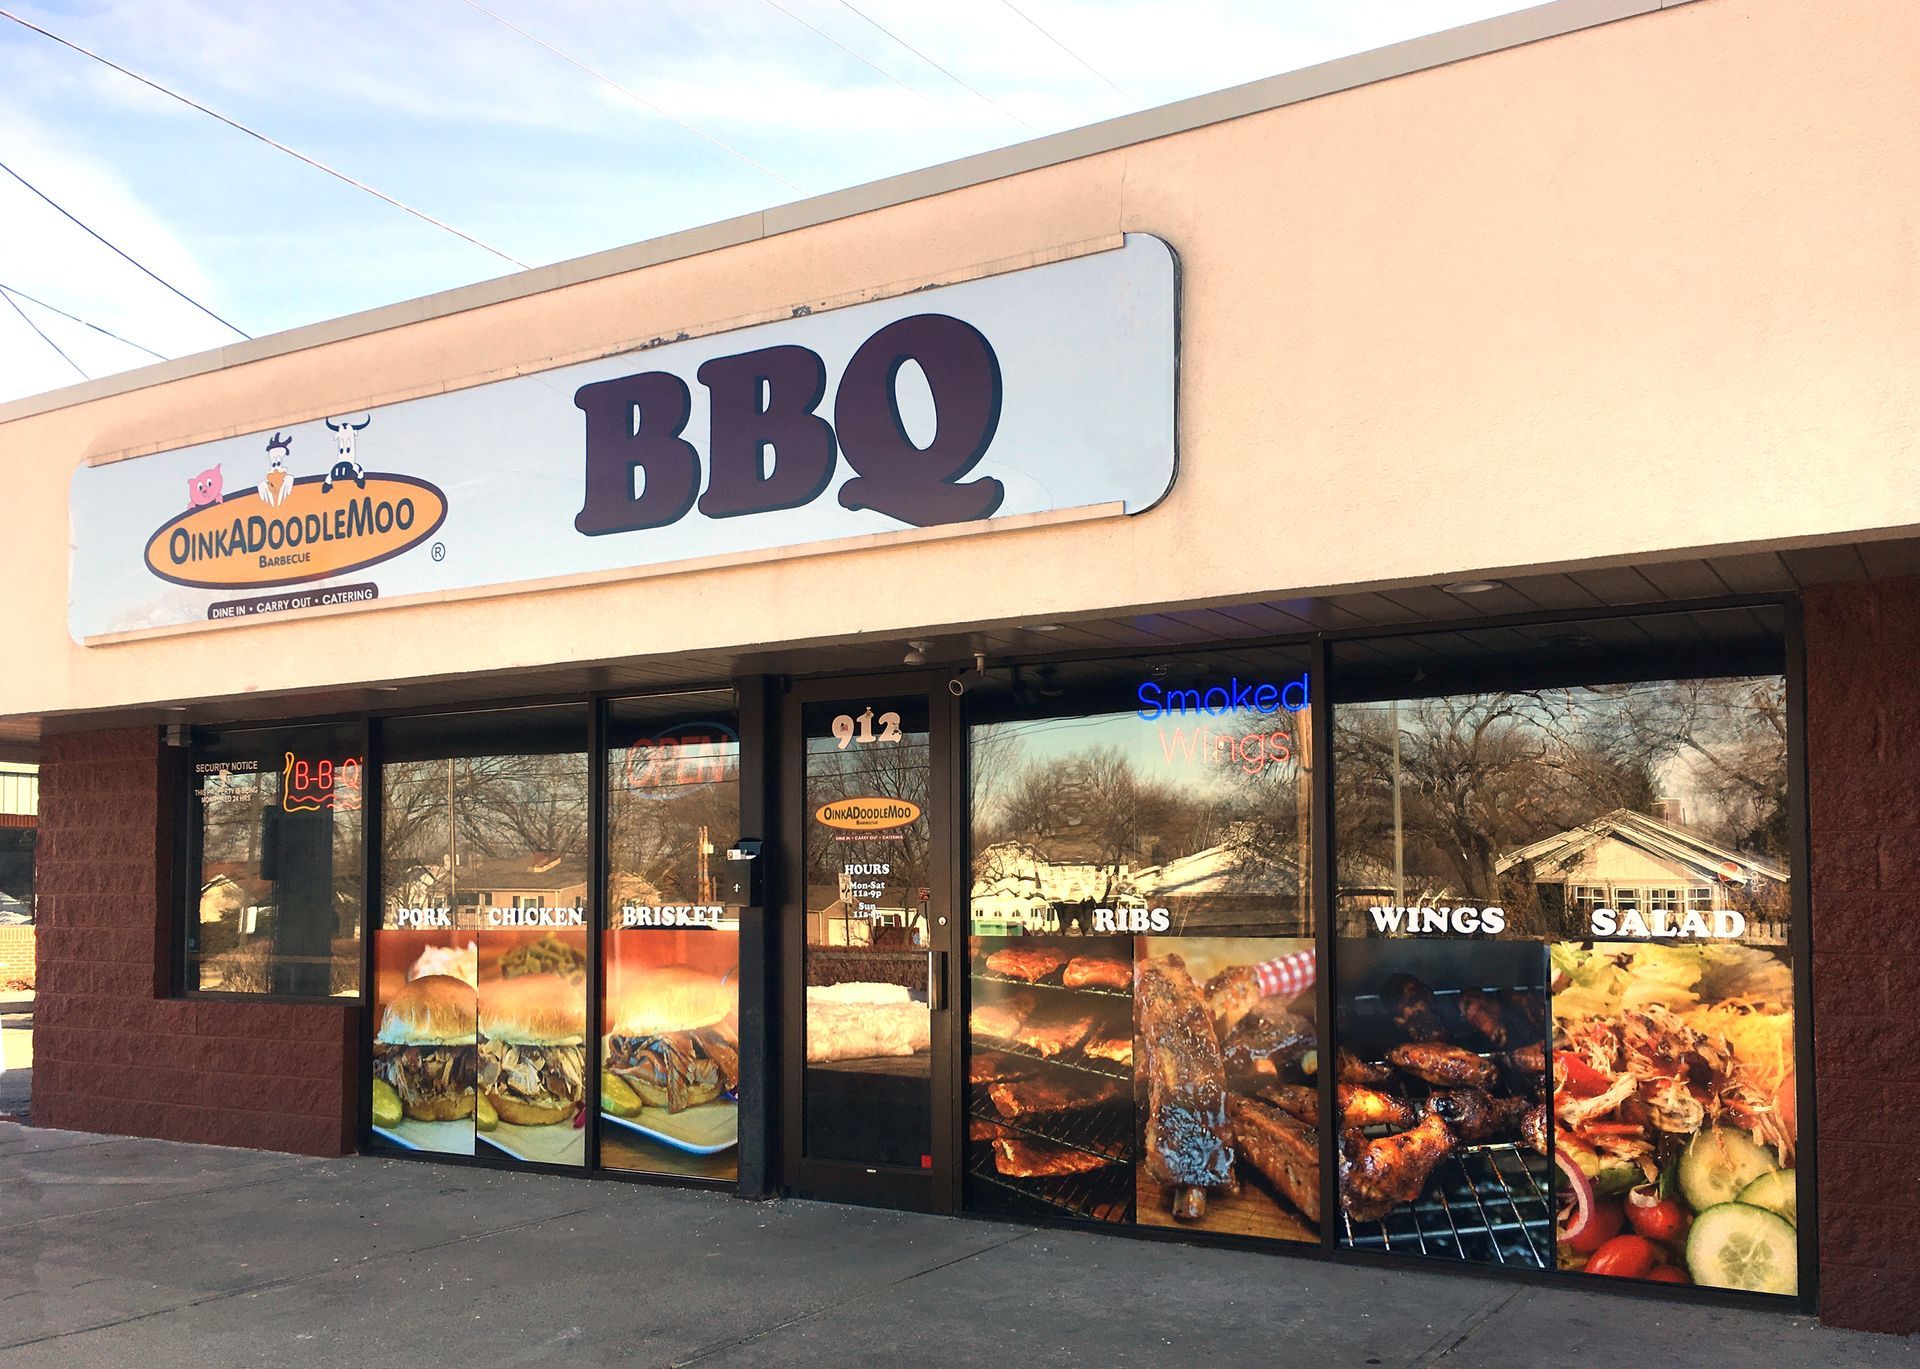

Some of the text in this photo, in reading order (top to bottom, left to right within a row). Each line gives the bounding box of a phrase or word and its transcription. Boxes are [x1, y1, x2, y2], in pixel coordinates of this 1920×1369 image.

[574, 313, 1005, 536] BBQ
[212, 589, 373, 619] DINE IN CARRY OUT CATERING
[1137, 672, 1310, 721] Smoked
[832, 709, 903, 750] 912
[625, 735, 729, 787] OPEN
[1158, 726, 1291, 774] Wings
[195, 760, 258, 773] SECURITY NOTICE
[844, 863, 891, 875] HOURS
[849, 881, 886, 890] Mon-Sat
[853, 889, 882, 899] 11a-9p
[397, 907, 452, 926] PORK
[488, 907, 584, 926] CHICKEN
[621, 905, 724, 927] BRISKET
[858, 902, 876, 911] Sun
[1093, 907, 1171, 932] RIBS
[1368, 906, 1506, 935] WINGS
[1590, 908, 1747, 938] SALAD
